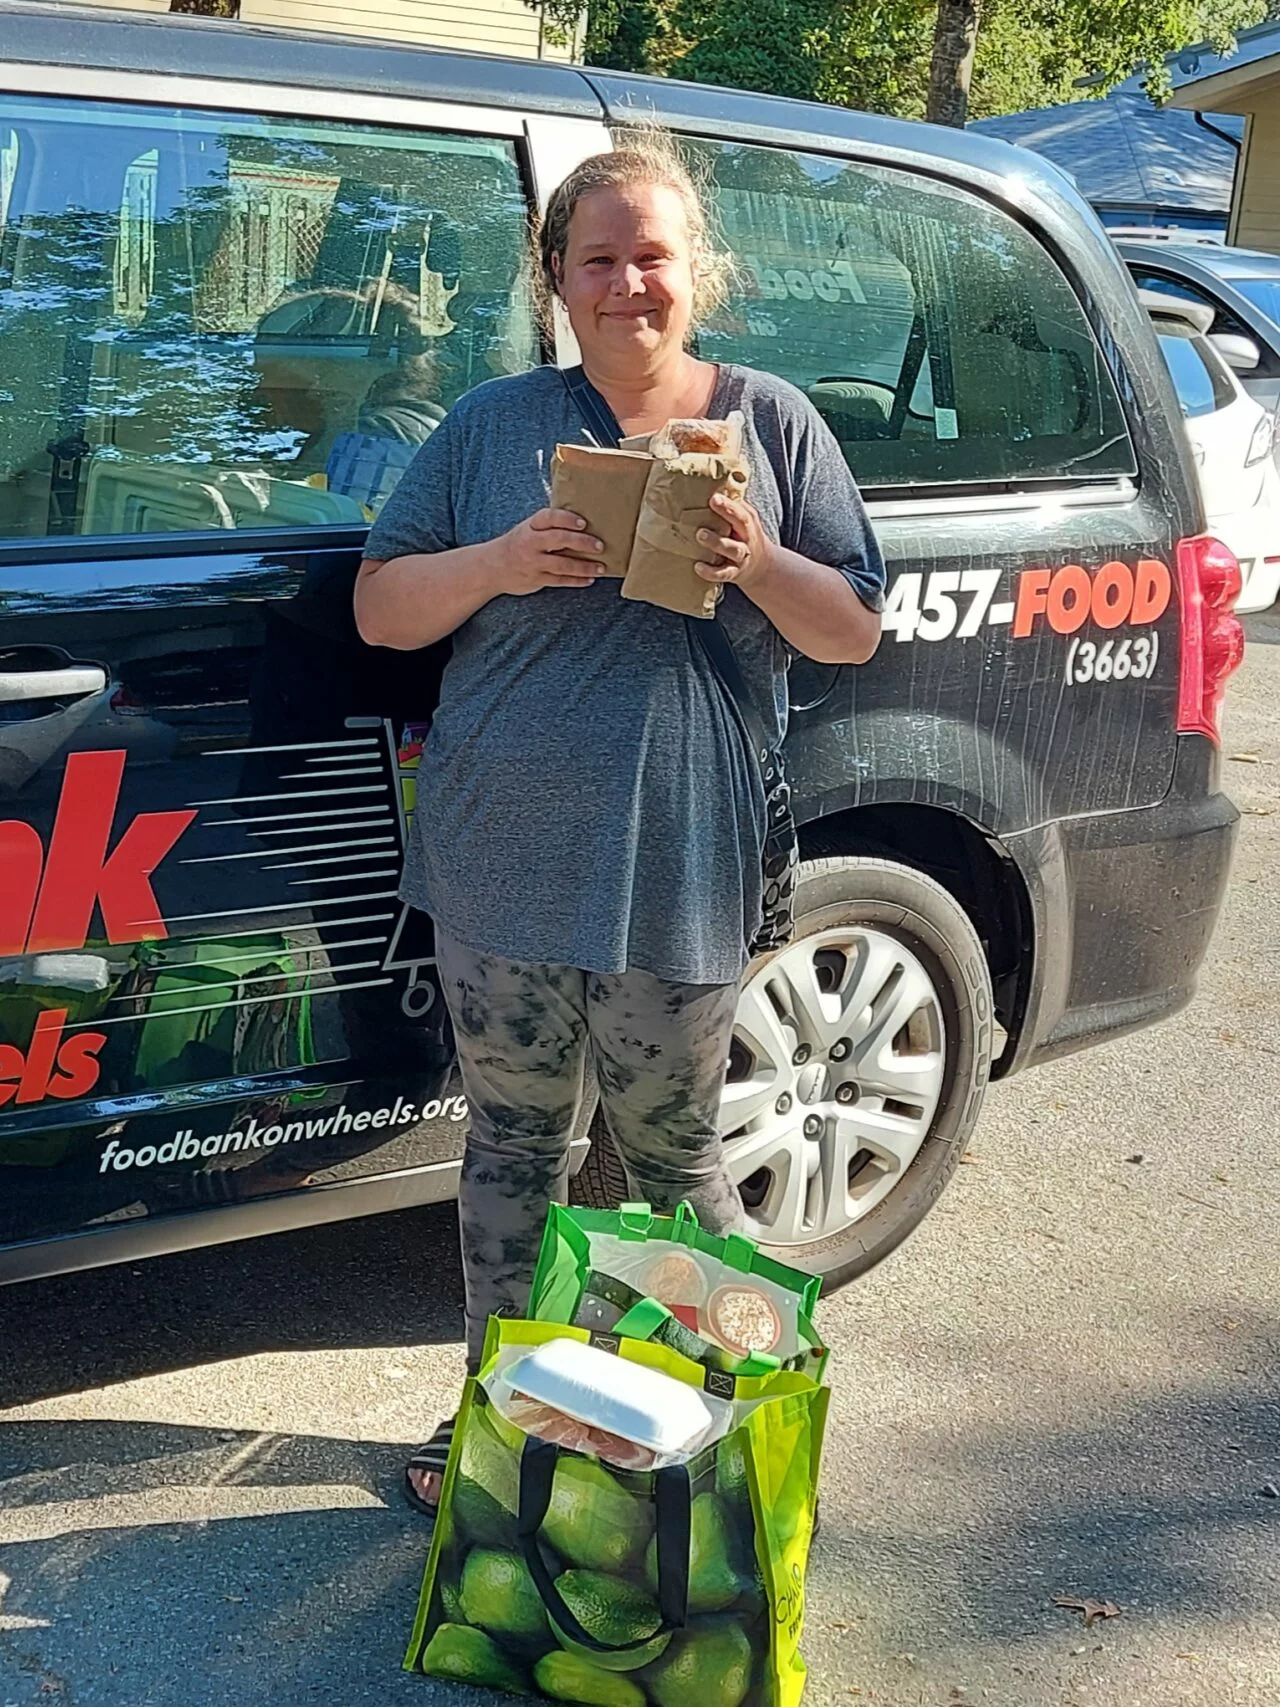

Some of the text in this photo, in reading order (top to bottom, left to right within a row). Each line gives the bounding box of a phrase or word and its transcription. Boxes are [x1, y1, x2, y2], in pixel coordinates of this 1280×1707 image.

[881, 560, 1171, 642] 457-FOOD
[1066, 631, 1159, 686] (3663)
[99, 1095, 468, 1173] foodbankonwheels.org
